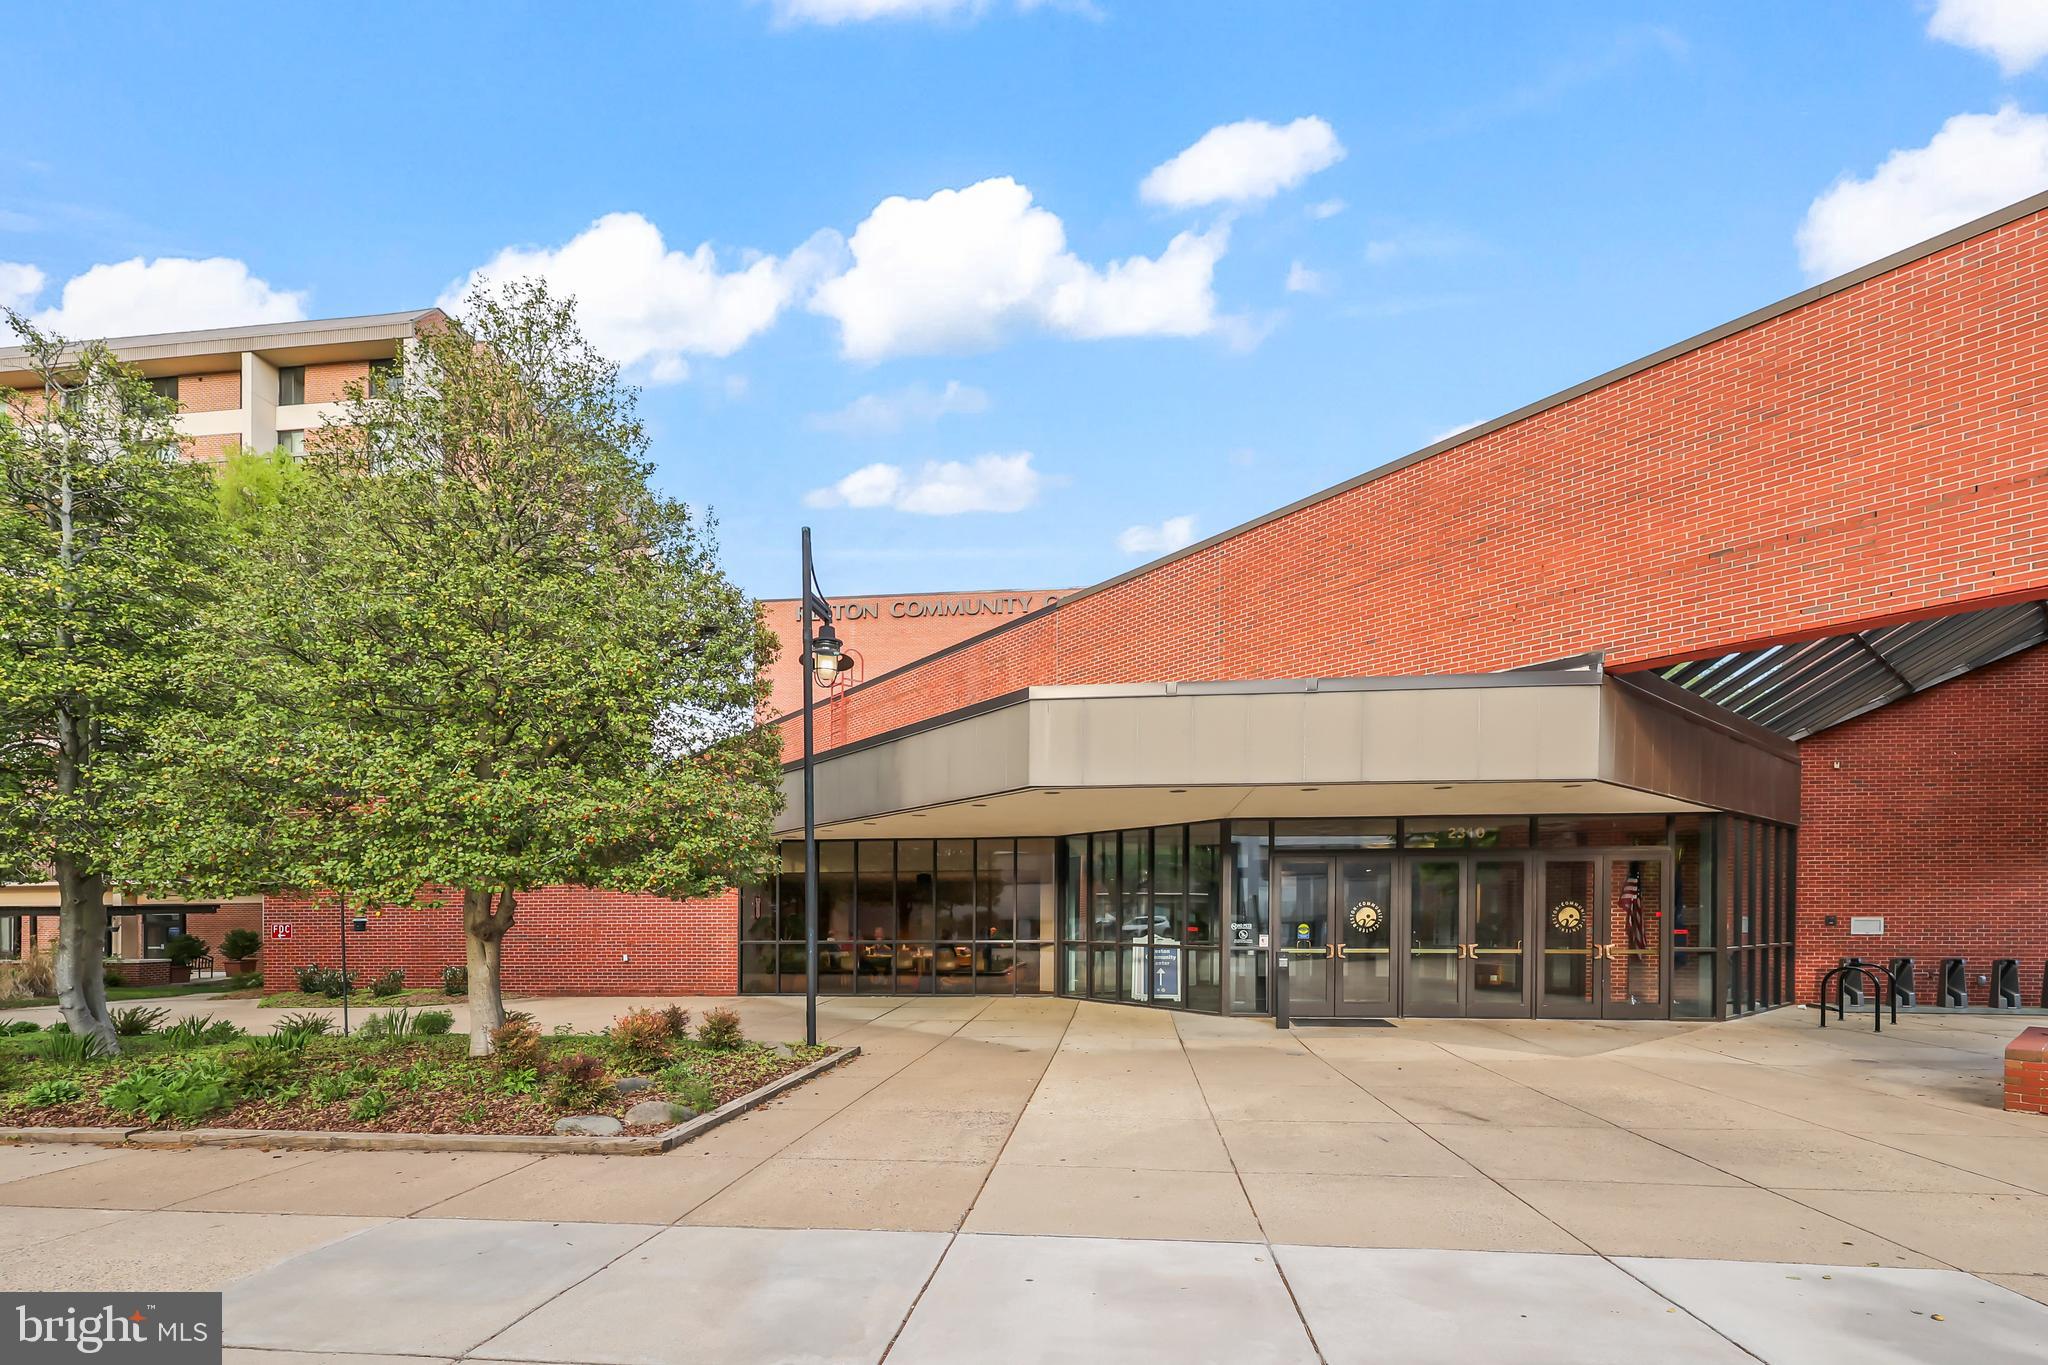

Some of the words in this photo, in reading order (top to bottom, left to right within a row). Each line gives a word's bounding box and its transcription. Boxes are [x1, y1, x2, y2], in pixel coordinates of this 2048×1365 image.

[890, 595, 1032, 618] COMMUNITY
[1447, 827, 1486, 839] 2310
[273, 924, 290, 933] FDC
